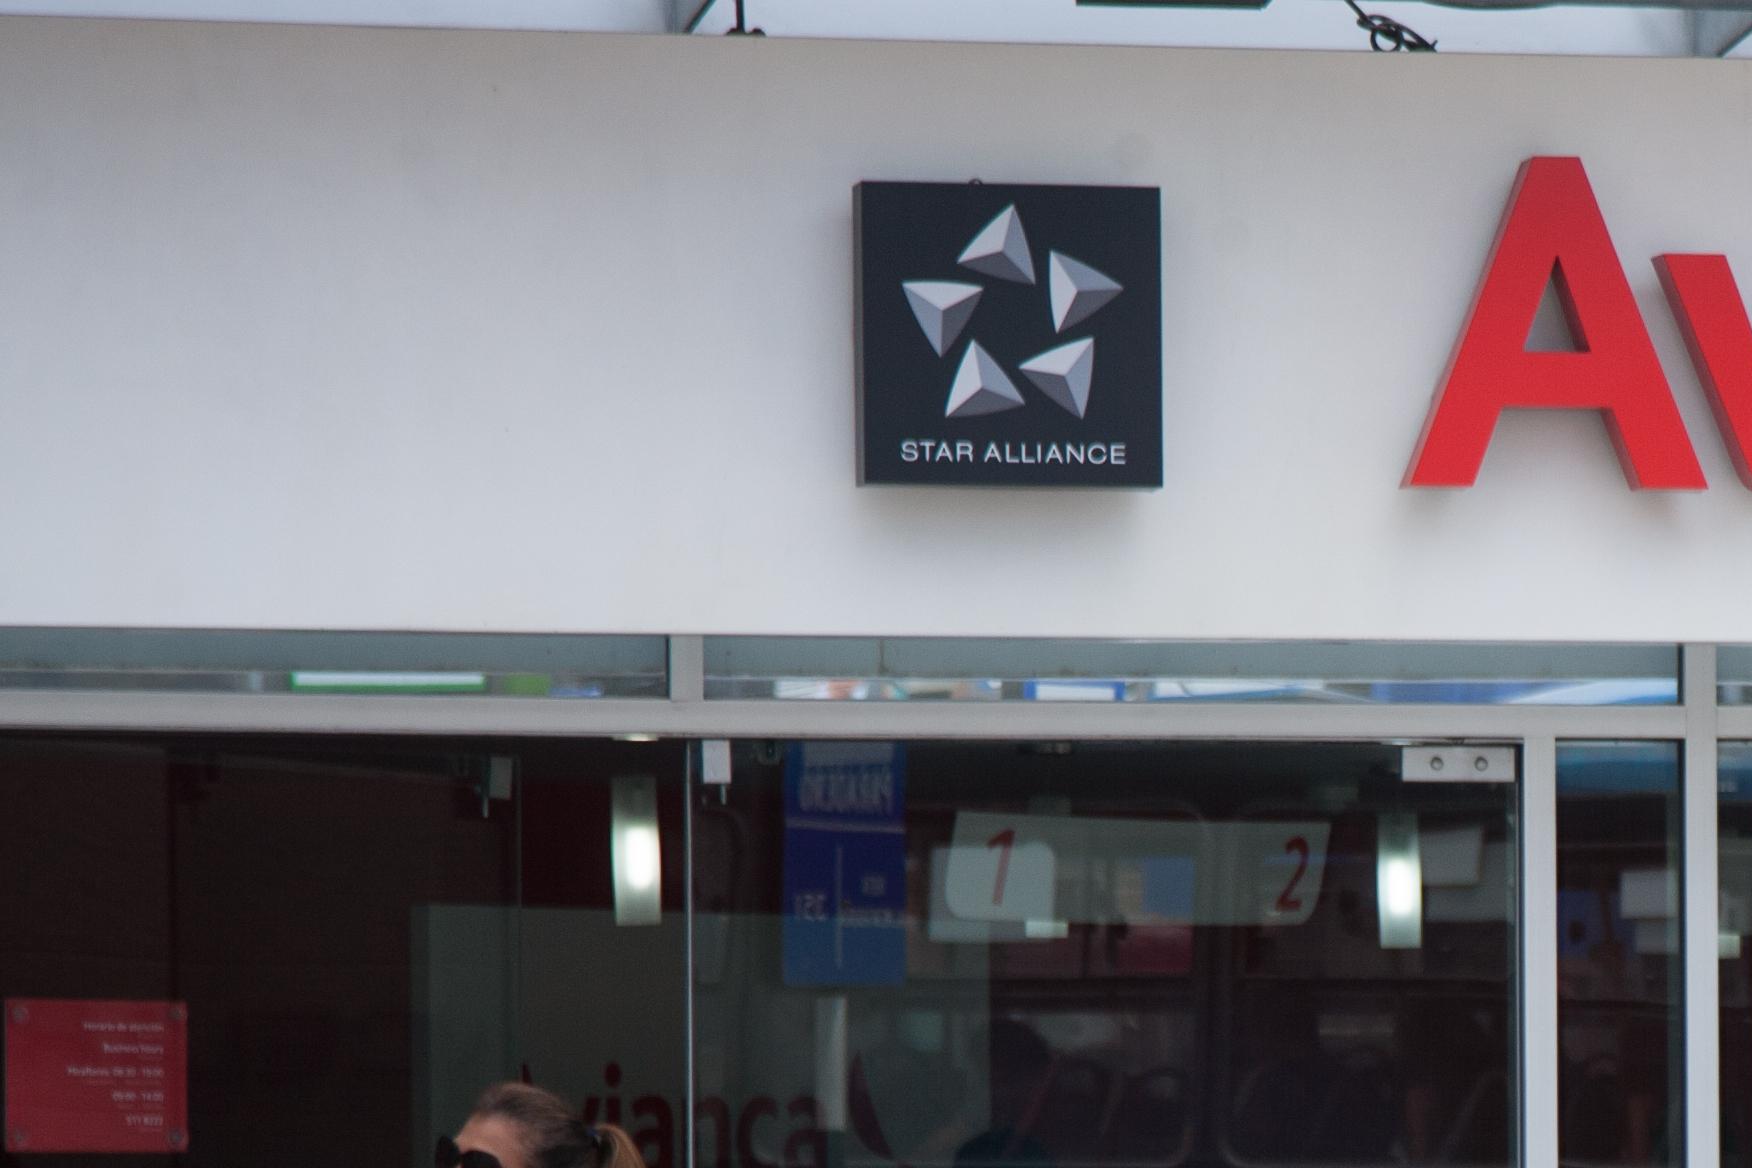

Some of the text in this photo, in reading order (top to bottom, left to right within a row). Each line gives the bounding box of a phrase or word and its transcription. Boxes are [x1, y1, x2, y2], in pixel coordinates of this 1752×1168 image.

[900, 440, 1127, 466] STAR ALLIANCE
[1275, 836, 1310, 912] 2
